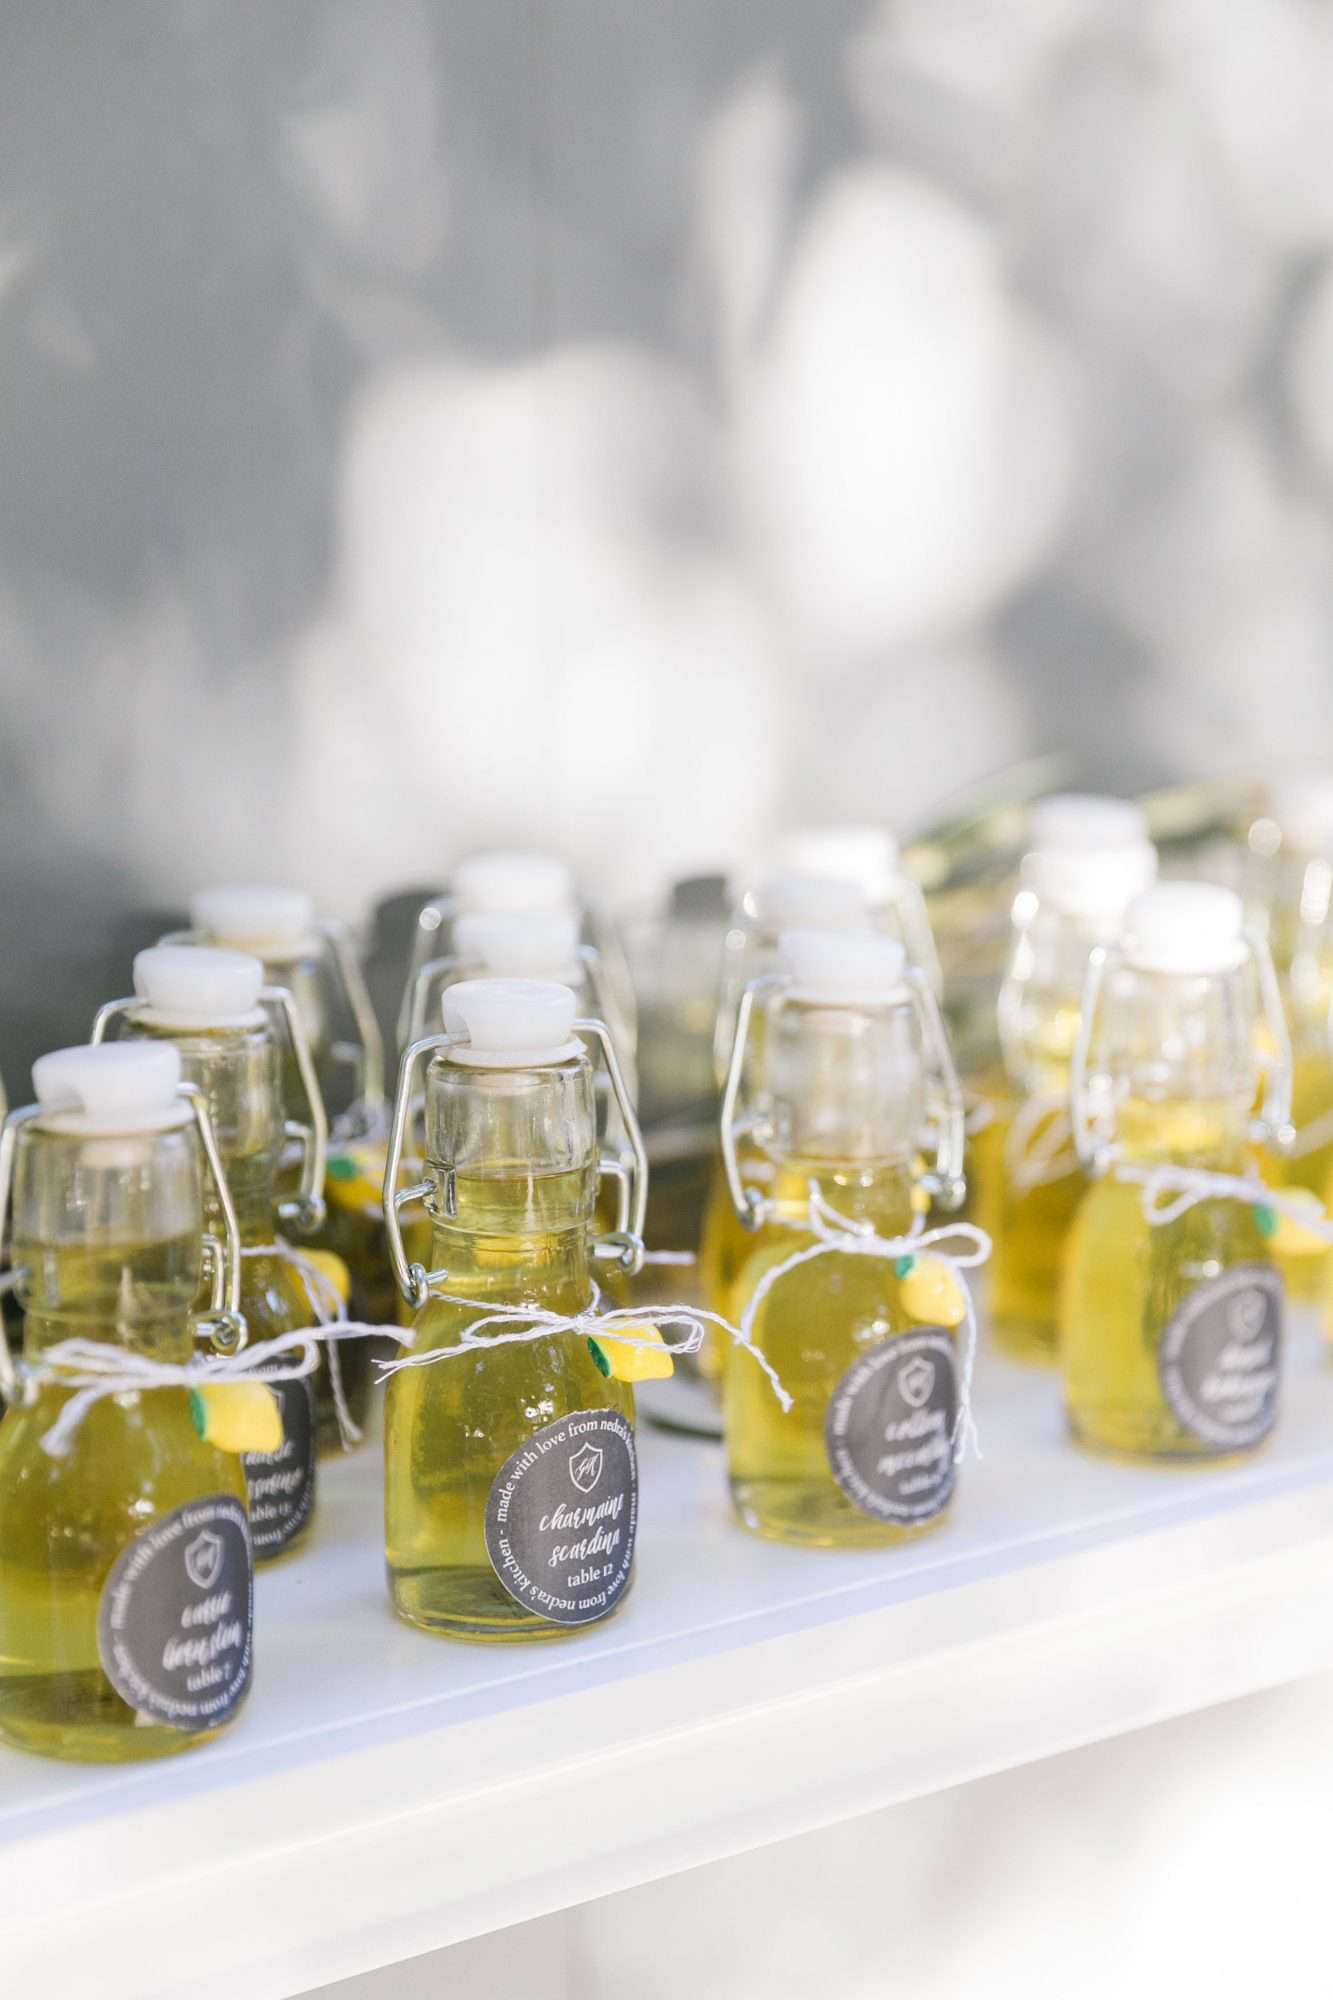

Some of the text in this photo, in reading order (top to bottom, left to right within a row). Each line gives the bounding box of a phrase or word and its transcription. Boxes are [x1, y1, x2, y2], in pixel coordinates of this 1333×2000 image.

[497, 1482, 516, 1522] made
[511, 1451, 539, 1481] with
[541, 1431, 567, 1455] love
[568, 1420, 599, 1438] from
[499, 1538, 532, 1593] kitchen
[567, 1563, 614, 1588] table 12
[578, 1592, 607, 1610] from
